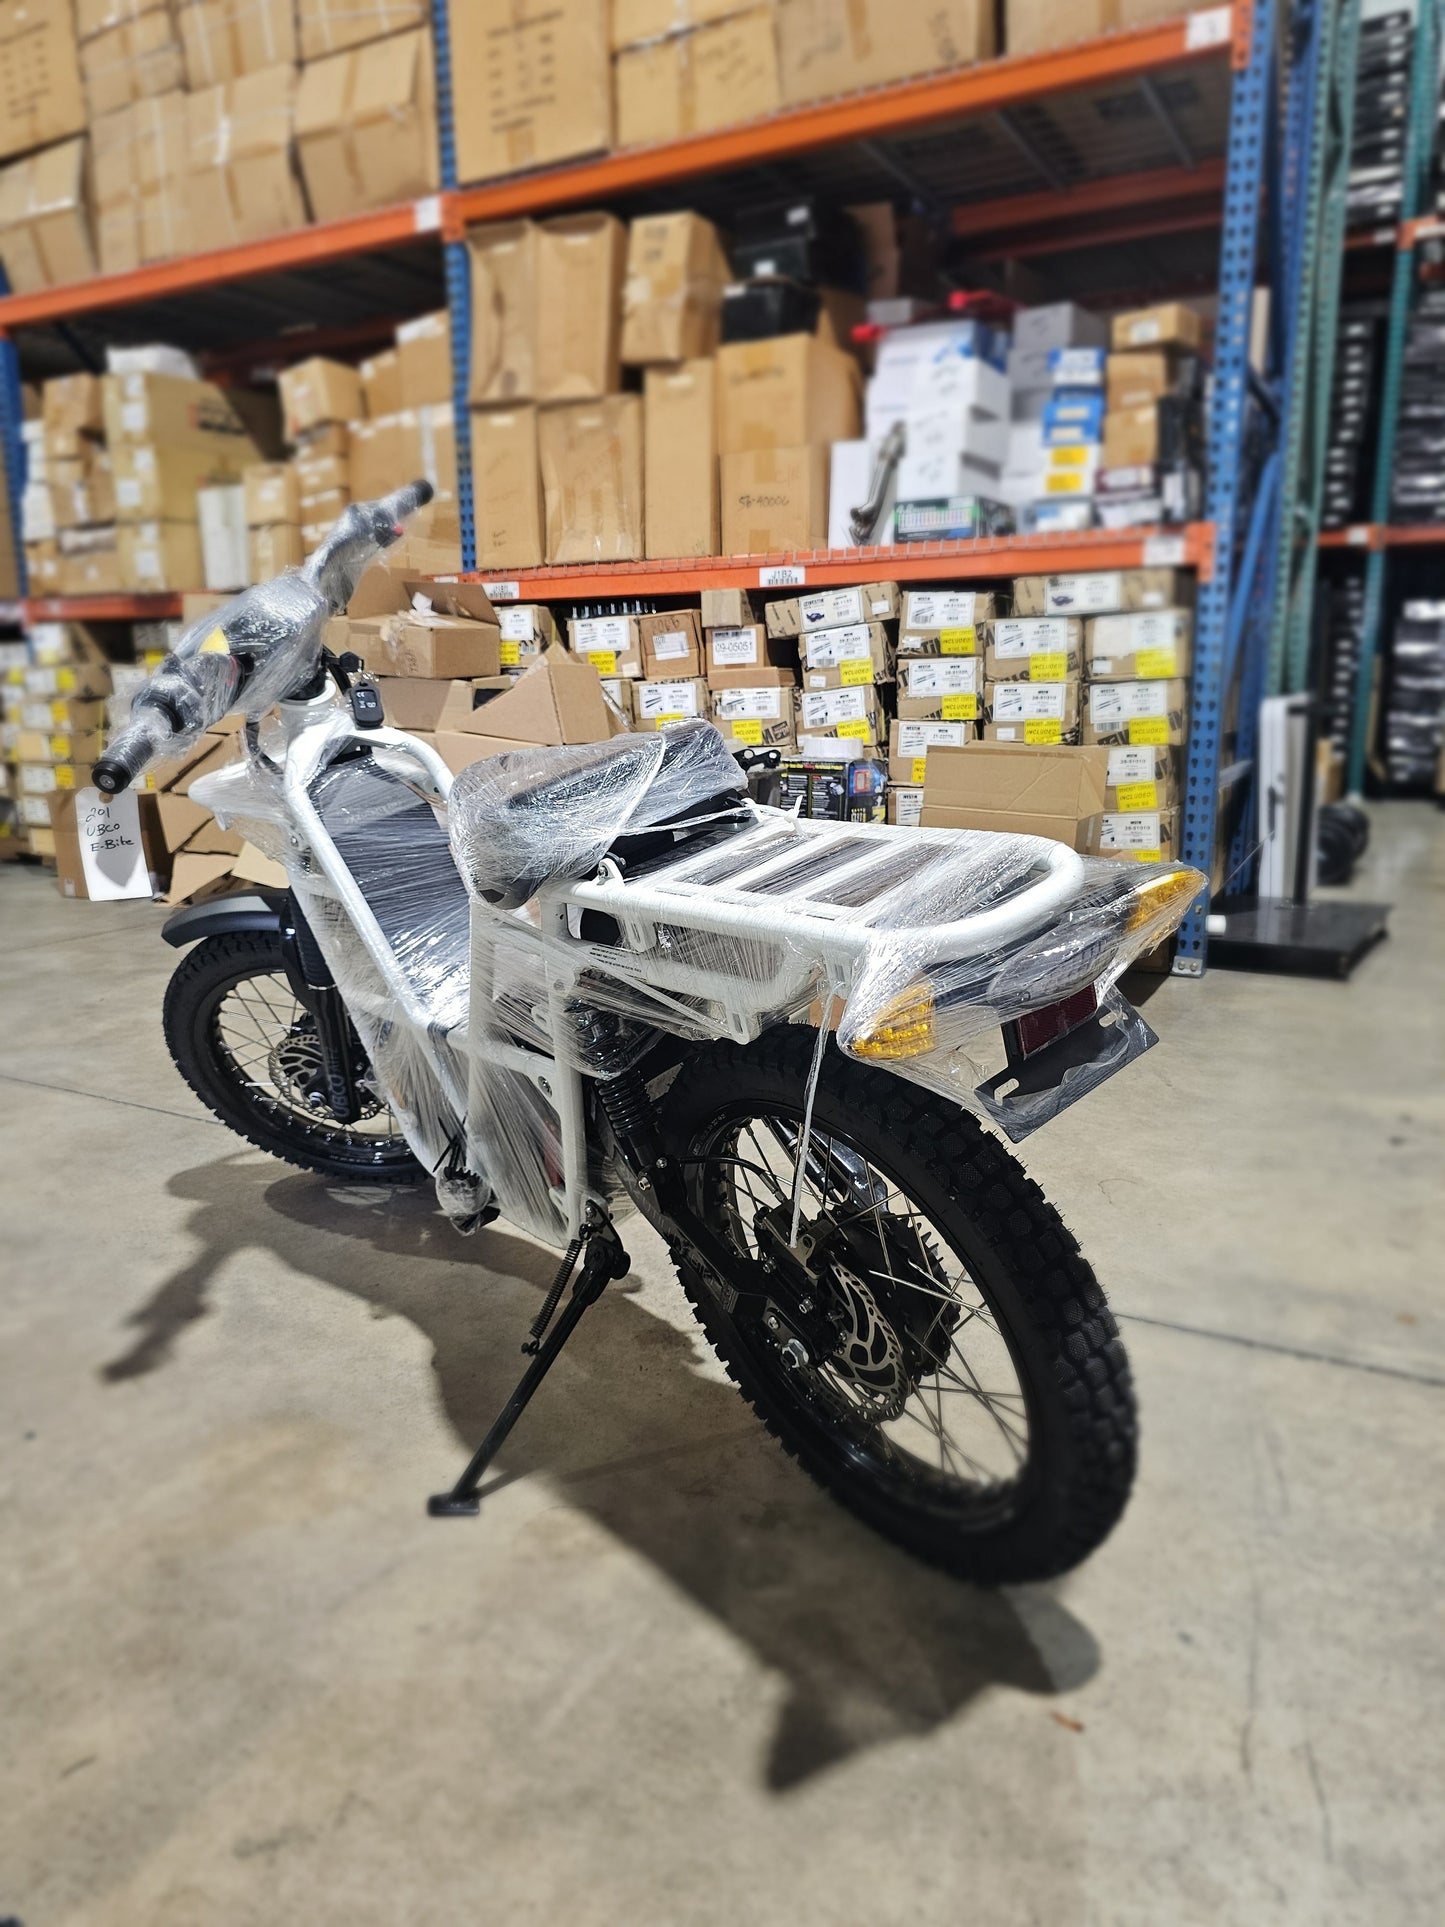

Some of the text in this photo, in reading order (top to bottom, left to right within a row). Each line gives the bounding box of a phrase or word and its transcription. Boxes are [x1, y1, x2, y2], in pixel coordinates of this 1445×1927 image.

[85, 807, 110, 822] 201
[86, 824, 120, 836] UBCO
[90, 836, 135, 852] E-Bike
[328, 1074, 351, 1118] UBCO
